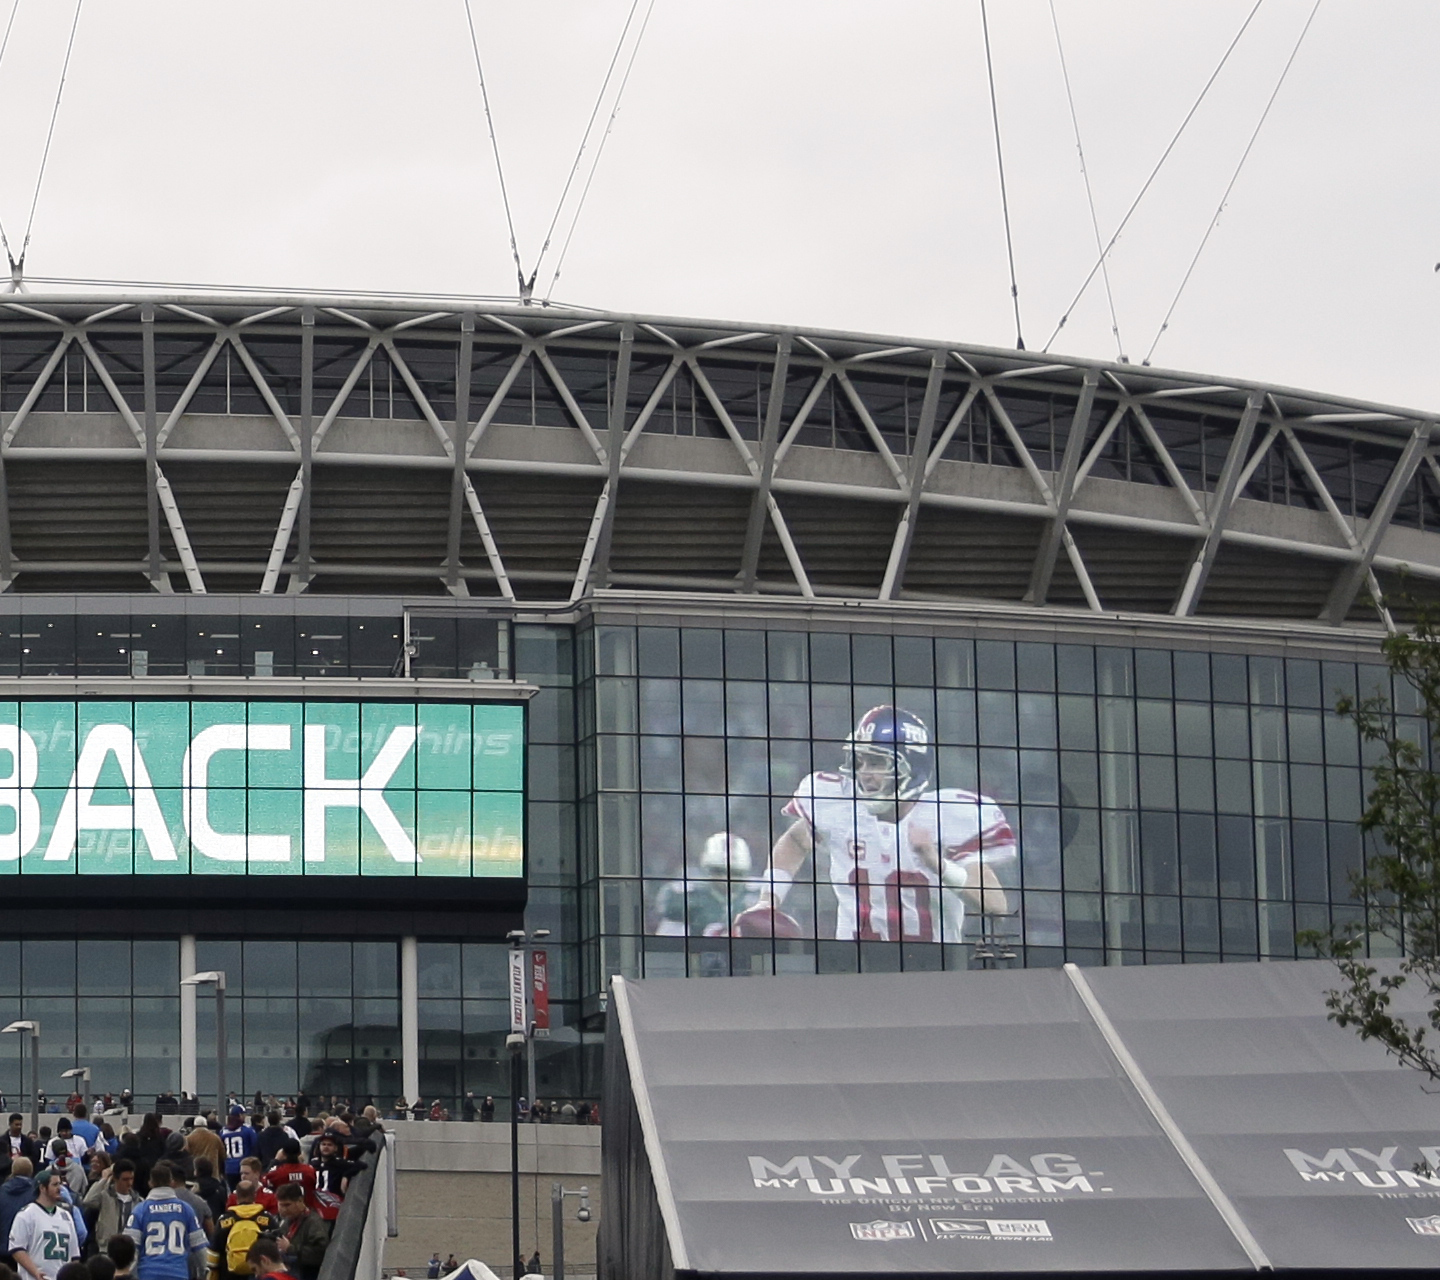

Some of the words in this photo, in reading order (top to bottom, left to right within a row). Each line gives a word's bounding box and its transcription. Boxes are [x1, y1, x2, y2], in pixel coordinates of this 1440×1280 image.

[848, 867, 935, 942] 10
[224, 1135, 244, 1158] 10
[747, 1153, 862, 1179] MY
[1283, 1146, 1399, 1173] MY
[289, 1172, 304, 1182] RYAN
[753, 1178, 800, 1188] MY
[806, 1176, 1113, 1195] UNIFORM.
[1299, 1170, 1346, 1182] MY
[149, 1202, 183, 1214] SANDERS
[819, 1197, 853, 1205] The
[857, 1196, 926, 1205] Official
[929, 1196, 964, 1205] NFL
[968, 1195, 1065, 1204] Collection
[889, 1204, 915, 1213] By
[918, 1204, 958, 1212] New
[145, 1220, 186, 1256] 20
[862, 1228, 906, 1239] NFL
[43, 1231, 70, 1262] 25
